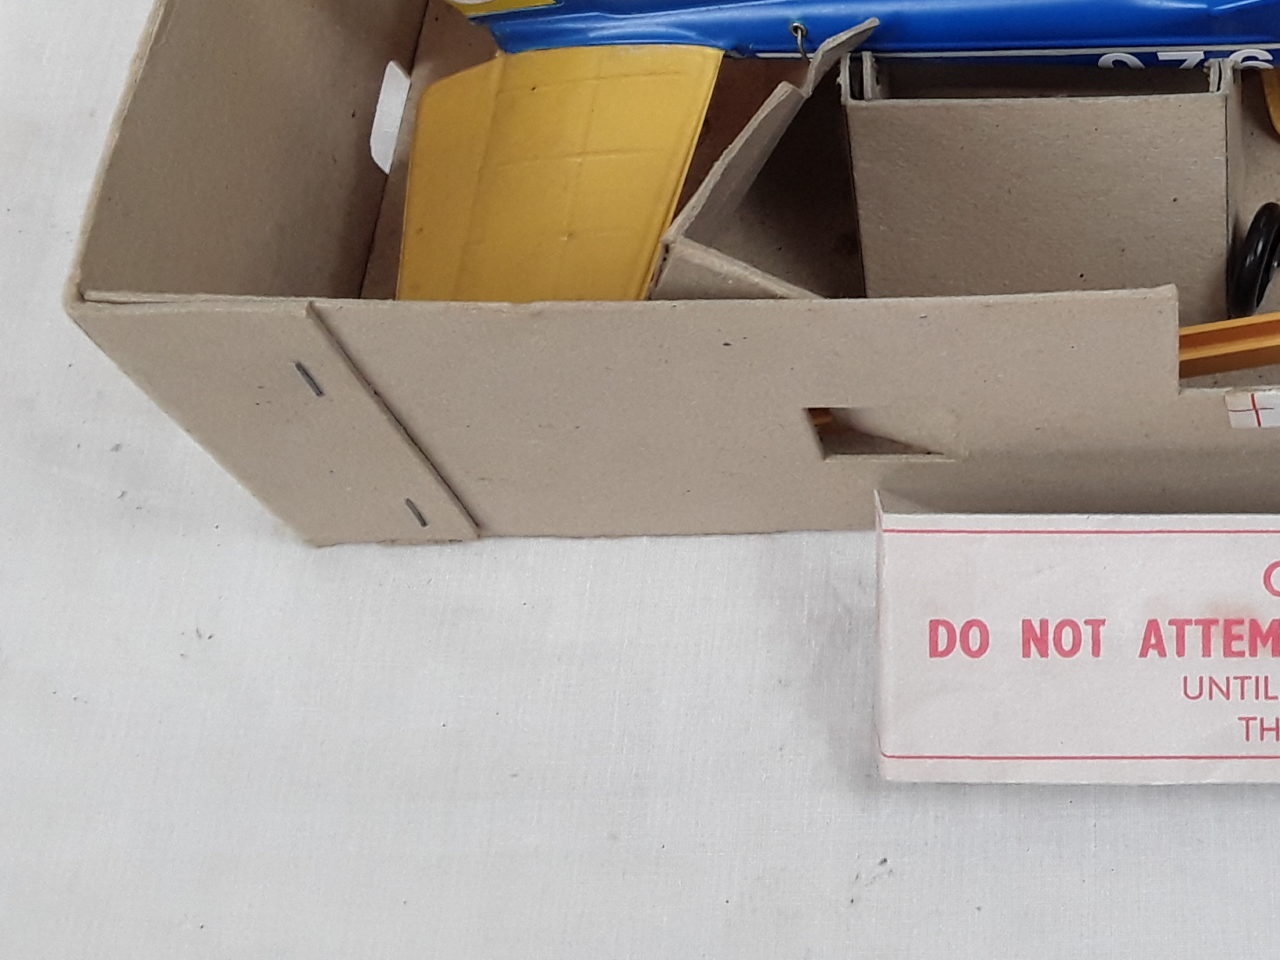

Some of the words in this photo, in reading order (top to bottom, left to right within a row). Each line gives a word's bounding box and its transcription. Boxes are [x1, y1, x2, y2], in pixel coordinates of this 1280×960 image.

[927, 617, 991, 659] DO
[1020, 618, 1107, 659] NOT
[1183, 675, 1280, 701] UNTIL
